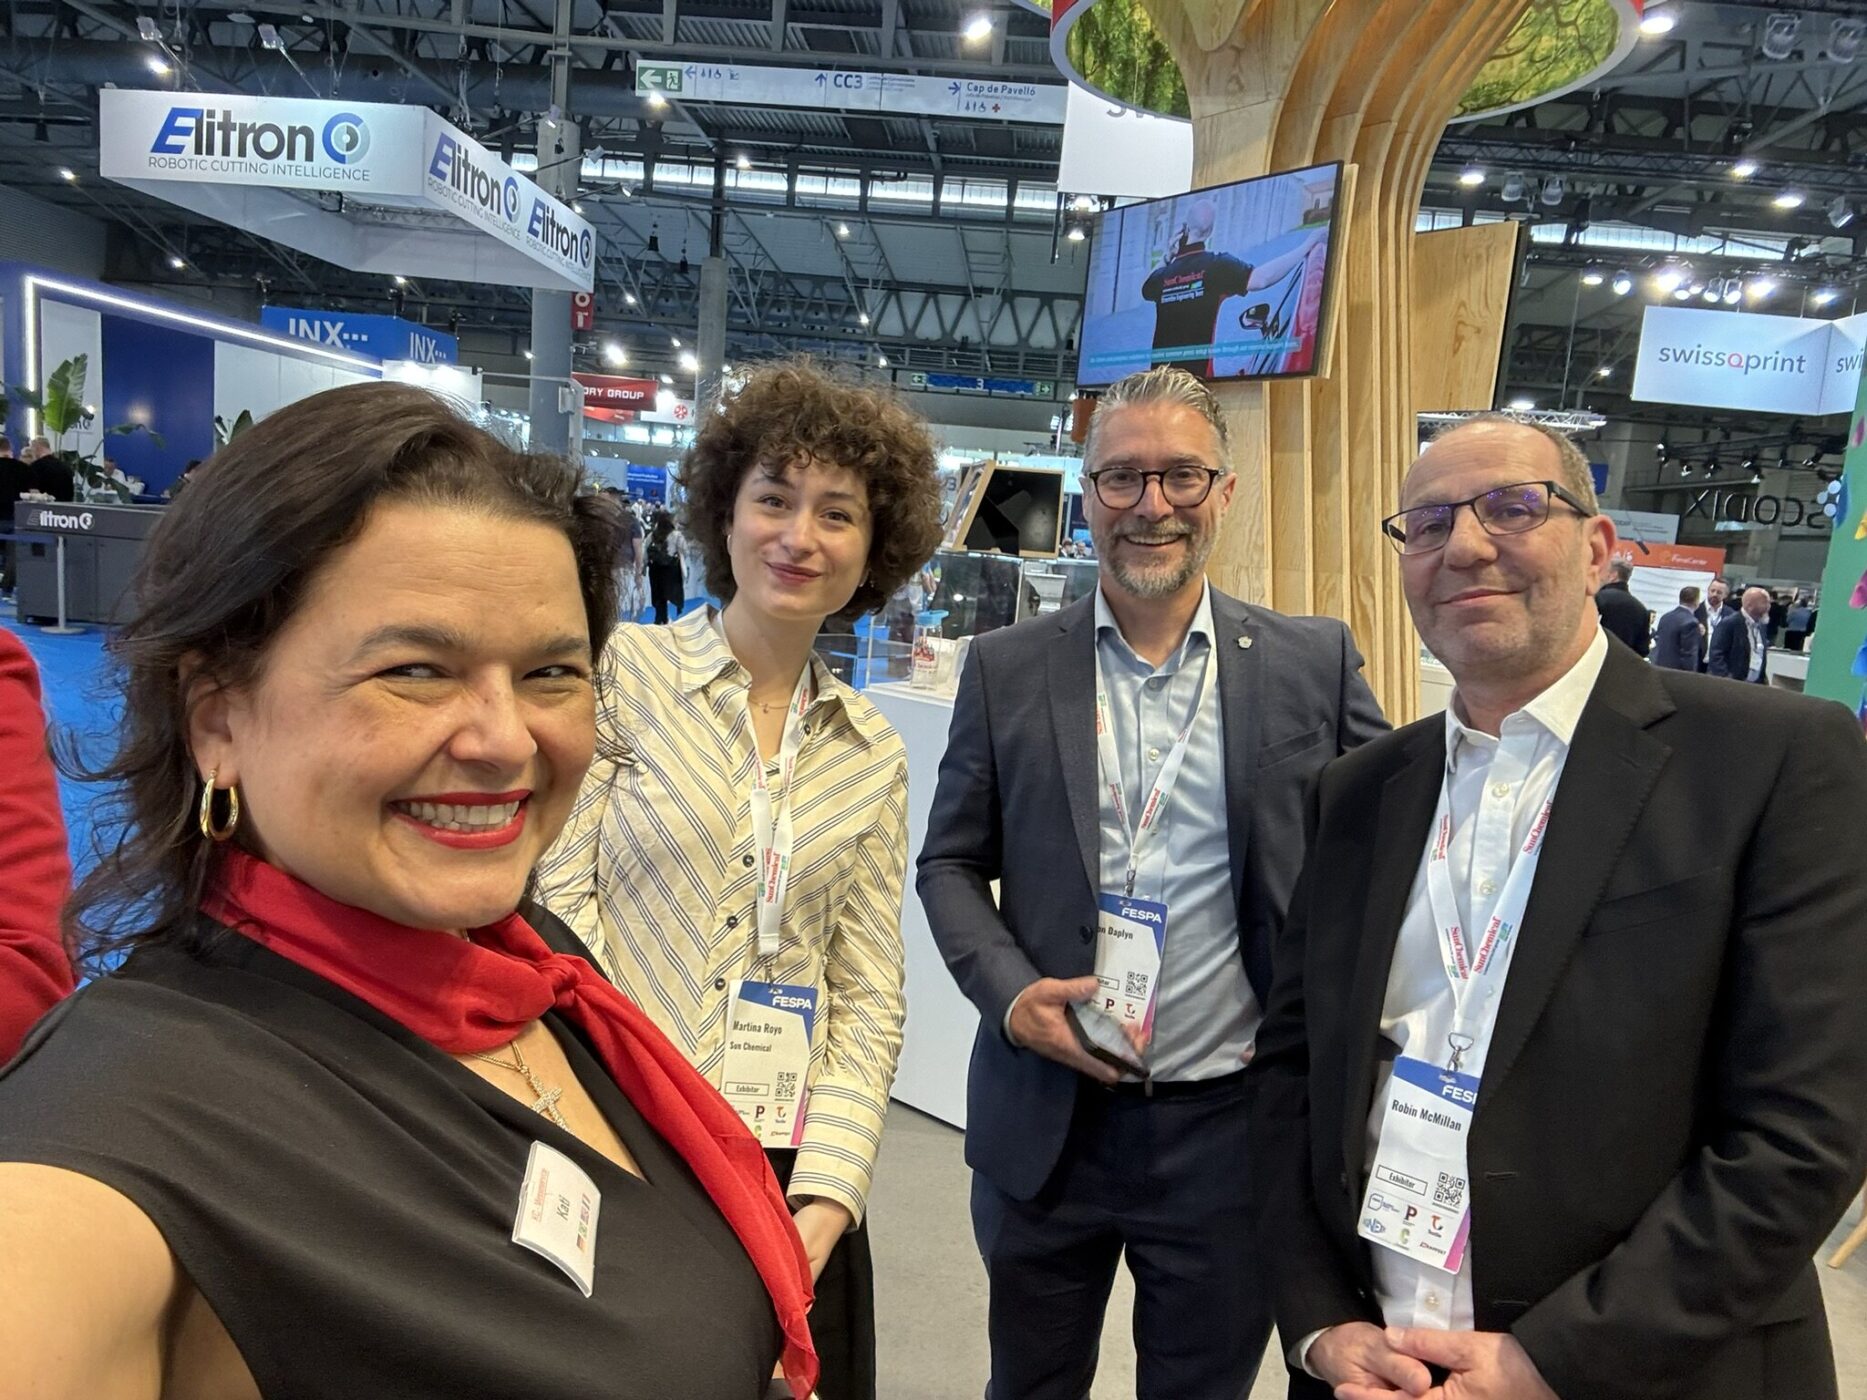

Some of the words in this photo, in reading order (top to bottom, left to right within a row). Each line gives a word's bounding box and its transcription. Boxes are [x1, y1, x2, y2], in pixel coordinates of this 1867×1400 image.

[833, 73, 863, 89] CC3
[967, 82, 985, 94] Cap
[987, 84, 999, 93] de
[151, 107, 315, 162] Elitron
[148, 156, 207, 171] ROBOTIC
[211, 160, 269, 175] CUTTING
[272, 164, 370, 182] INTELLIGENCE
[429, 131, 501, 215] Elitron
[427, 177, 457, 204] ROBOTIC
[458, 194, 483, 219] CUTTING
[484, 211, 521, 241] INTELLIGENCE
[527, 197, 578, 263] Elitron
[289, 318, 344, 349] INX
[410, 332, 436, 364] INX
[607, 389, 645, 400] GROUP
[976, 378, 984, 390] 3
[1523, 799, 1552, 854] SunChemical
[766, 852, 780, 903] SunChemical
[1121, 907, 1162, 924] FESPA
[1108, 926, 1134, 940] Daplyn
[1473, 916, 1502, 974] SunChemical
[1450, 926, 1469, 980] SunChemical
[772, 995, 812, 1010] FESPA
[733, 1020, 762, 1033] Martina
[763, 1023, 783, 1036] Royo
[730, 1041, 741, 1050] Sun
[743, 1042, 772, 1053] Chemical
[1391, 1099, 1418, 1118] Robin
[1419, 1109, 1462, 1132] McMillan
[1388, 1172, 1415, 1189] Exhibitor
[556, 1194, 570, 1221] Kati
